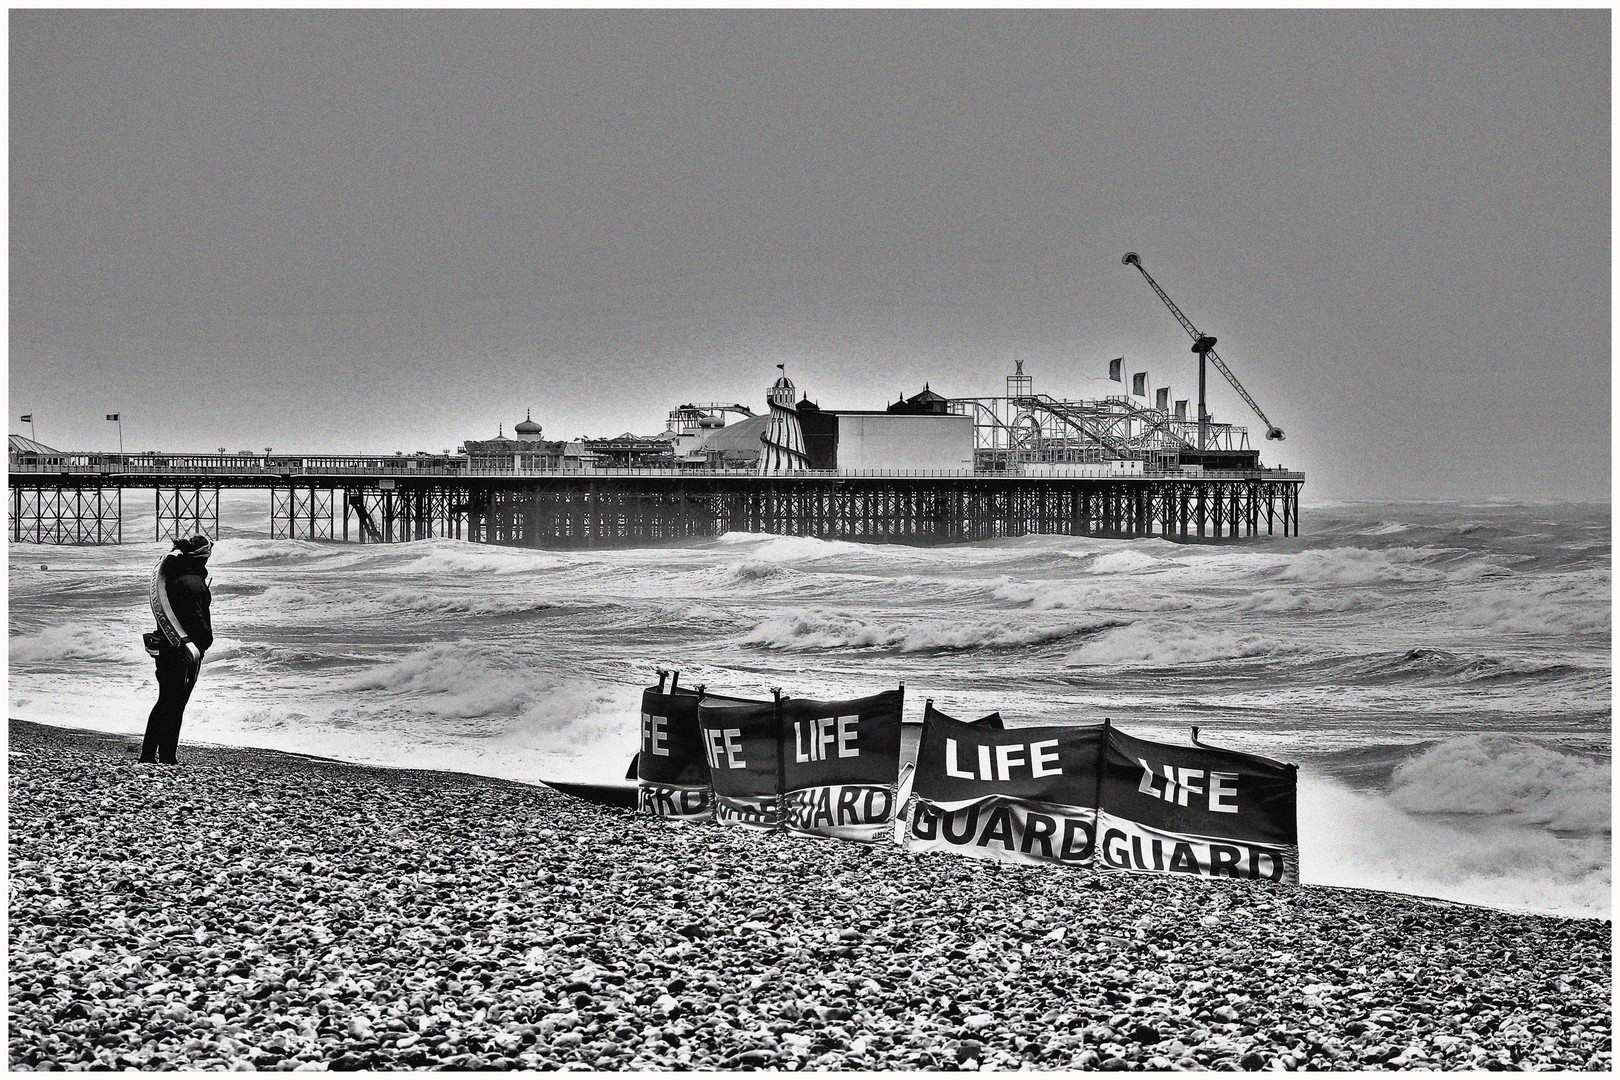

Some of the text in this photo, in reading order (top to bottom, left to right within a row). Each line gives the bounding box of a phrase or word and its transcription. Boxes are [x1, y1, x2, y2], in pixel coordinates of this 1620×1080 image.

[794, 714, 860, 763] LIFE
[945, 738, 1062, 781] LIFE
[1137, 758, 1239, 814] LIFE
[912, 802, 1096, 860] GUARD
[1102, 828, 1284, 883] GUARD
